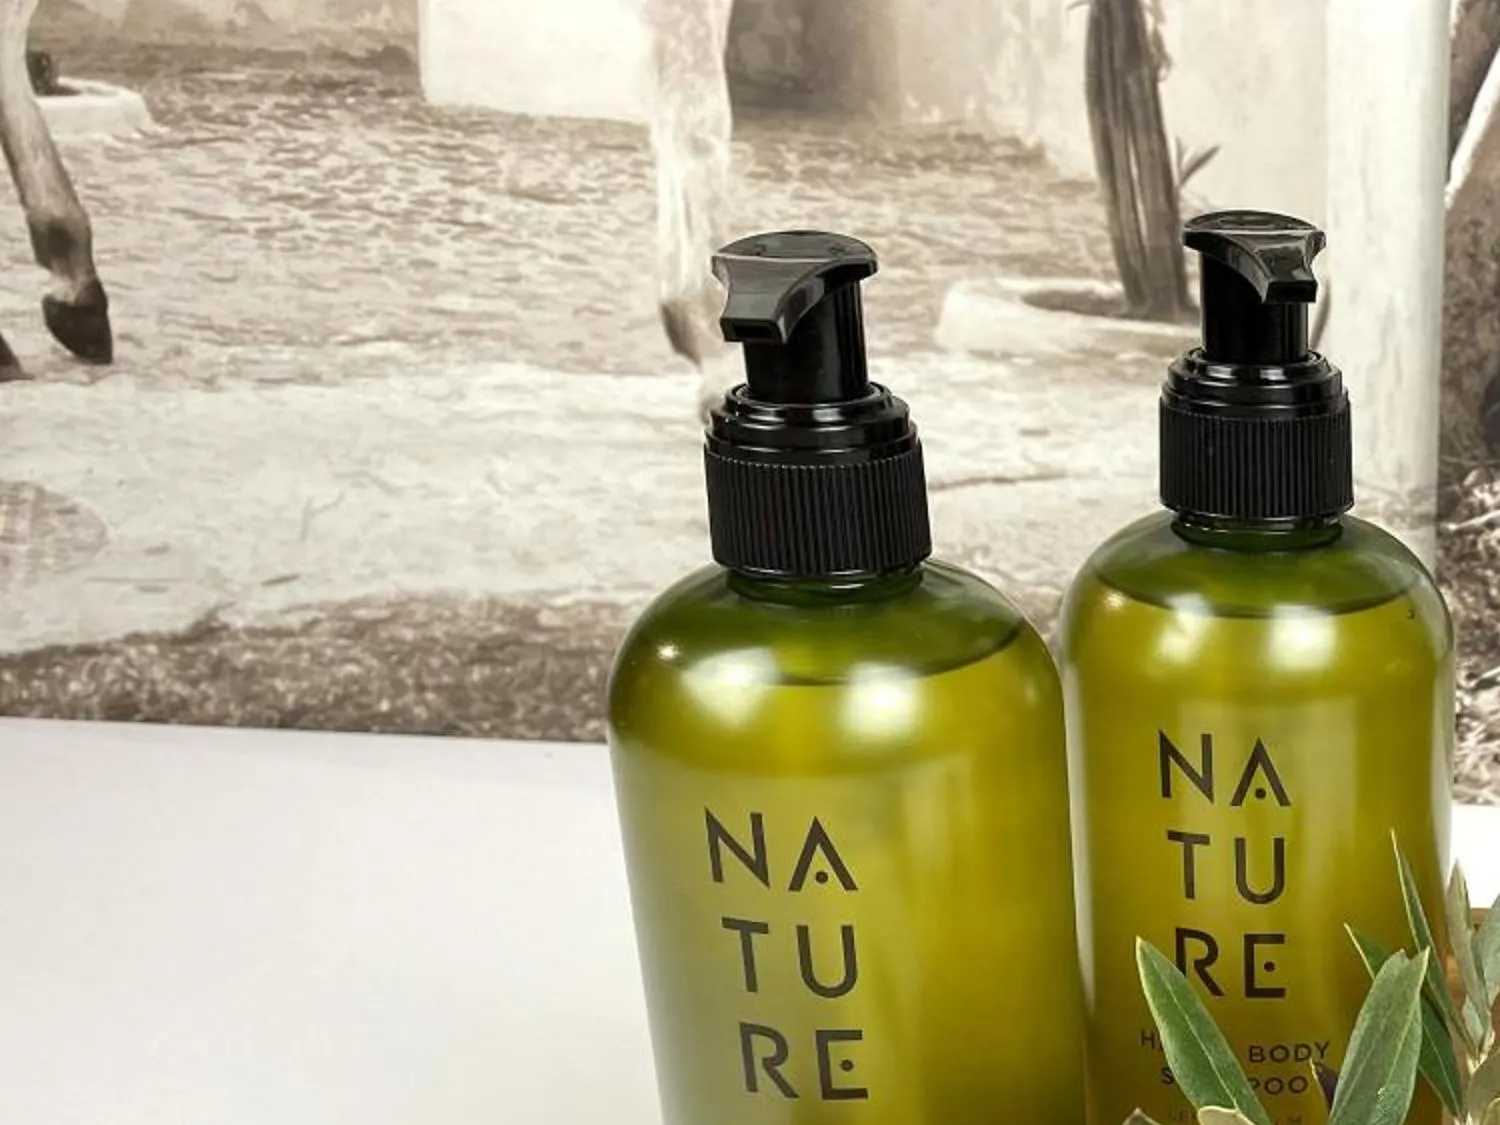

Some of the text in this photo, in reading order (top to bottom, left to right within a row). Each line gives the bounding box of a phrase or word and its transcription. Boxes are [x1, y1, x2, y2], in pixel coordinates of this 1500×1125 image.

[1158, 728, 1291, 807] NA
[704, 806, 859, 892] NA
[1166, 829, 1285, 904] TU
[721, 916, 860, 999] TU
[1173, 927, 1286, 998] RE
[739, 1022, 869, 1101] RE
[1249, 1040, 1329, 1062] BODY
